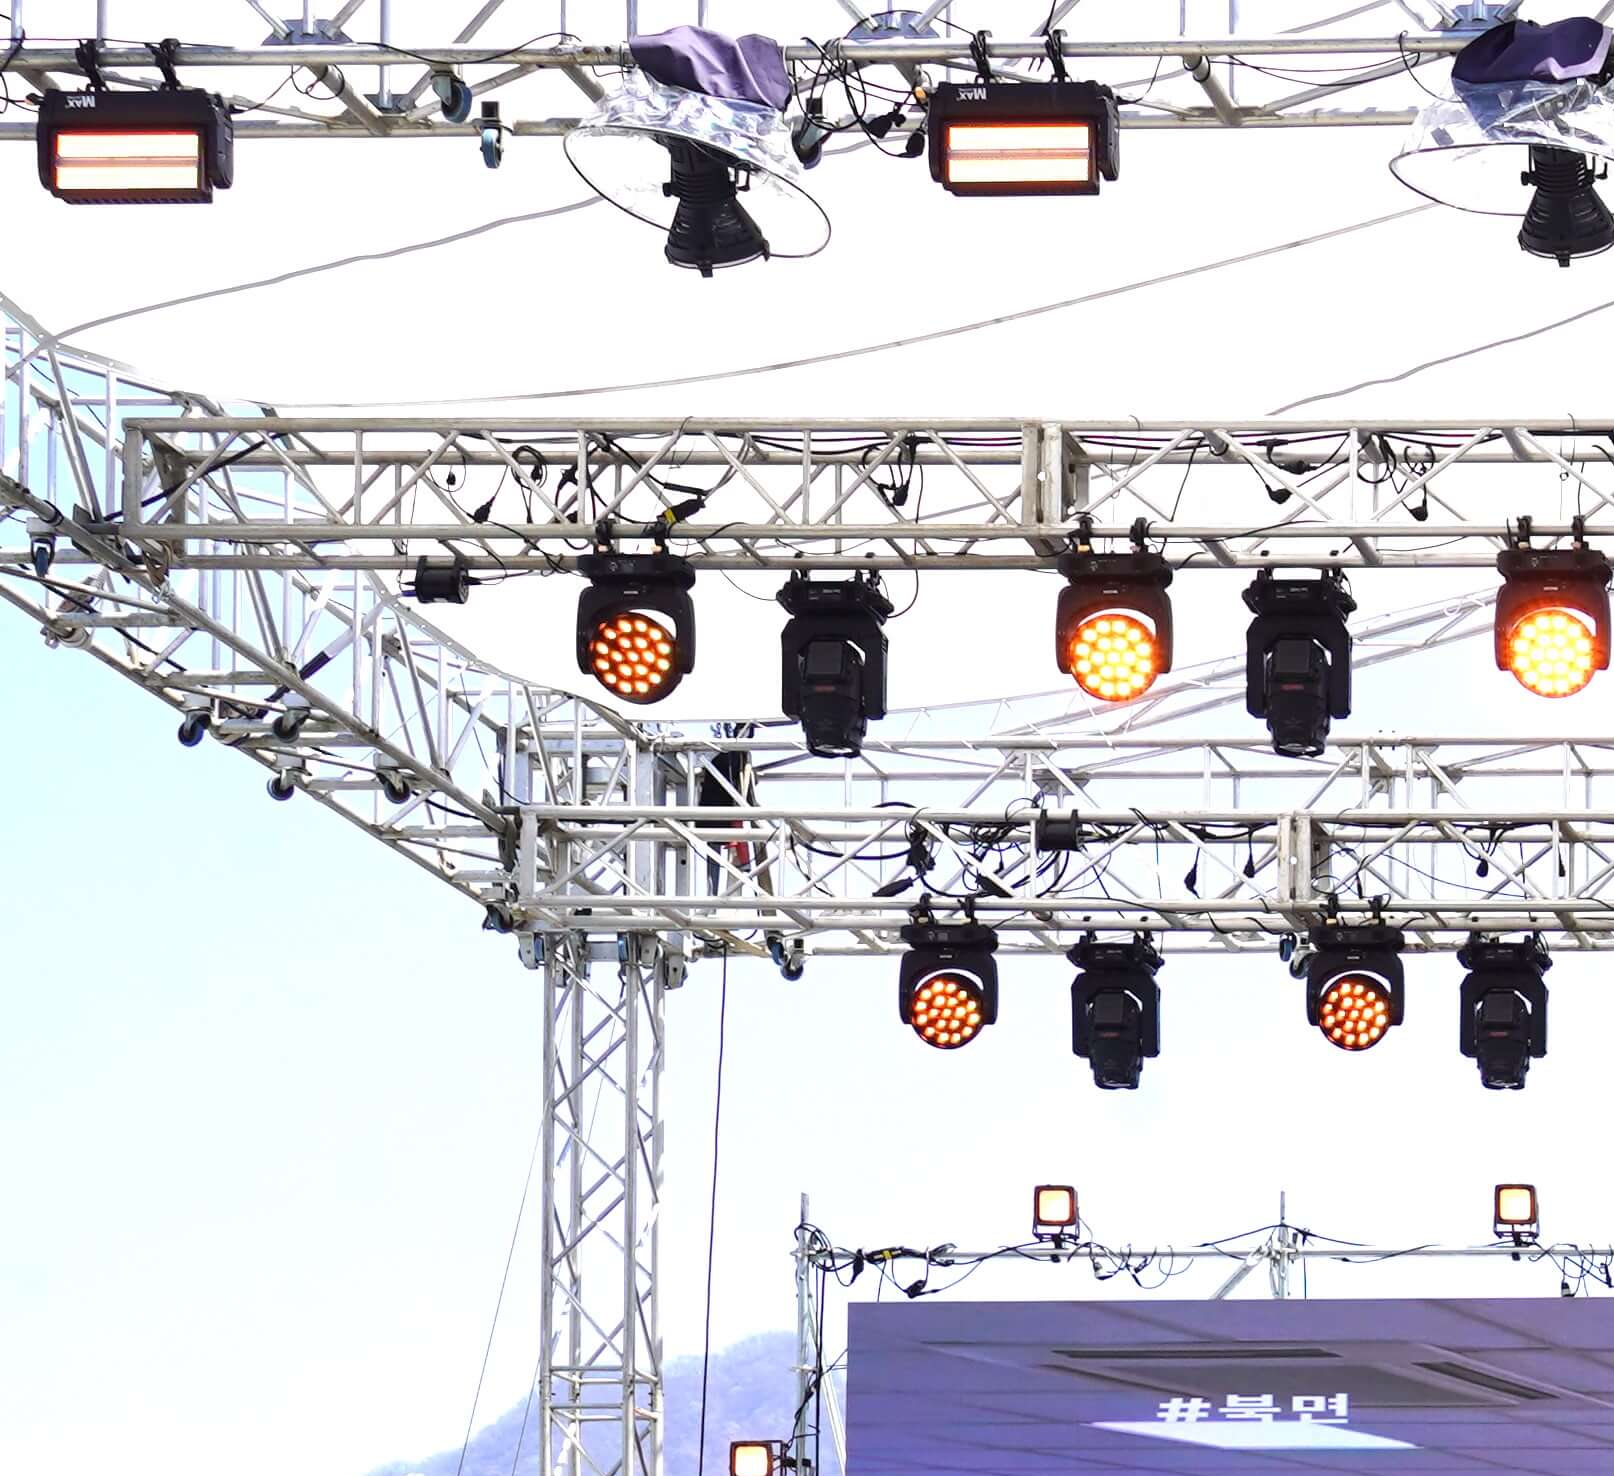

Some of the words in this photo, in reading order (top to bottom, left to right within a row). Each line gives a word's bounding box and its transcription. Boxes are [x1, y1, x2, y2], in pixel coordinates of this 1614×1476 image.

[959, 88, 987, 101] MAX
[67, 96, 96, 108] MAX
[1157, 1394, 1348, 1424] #북면
